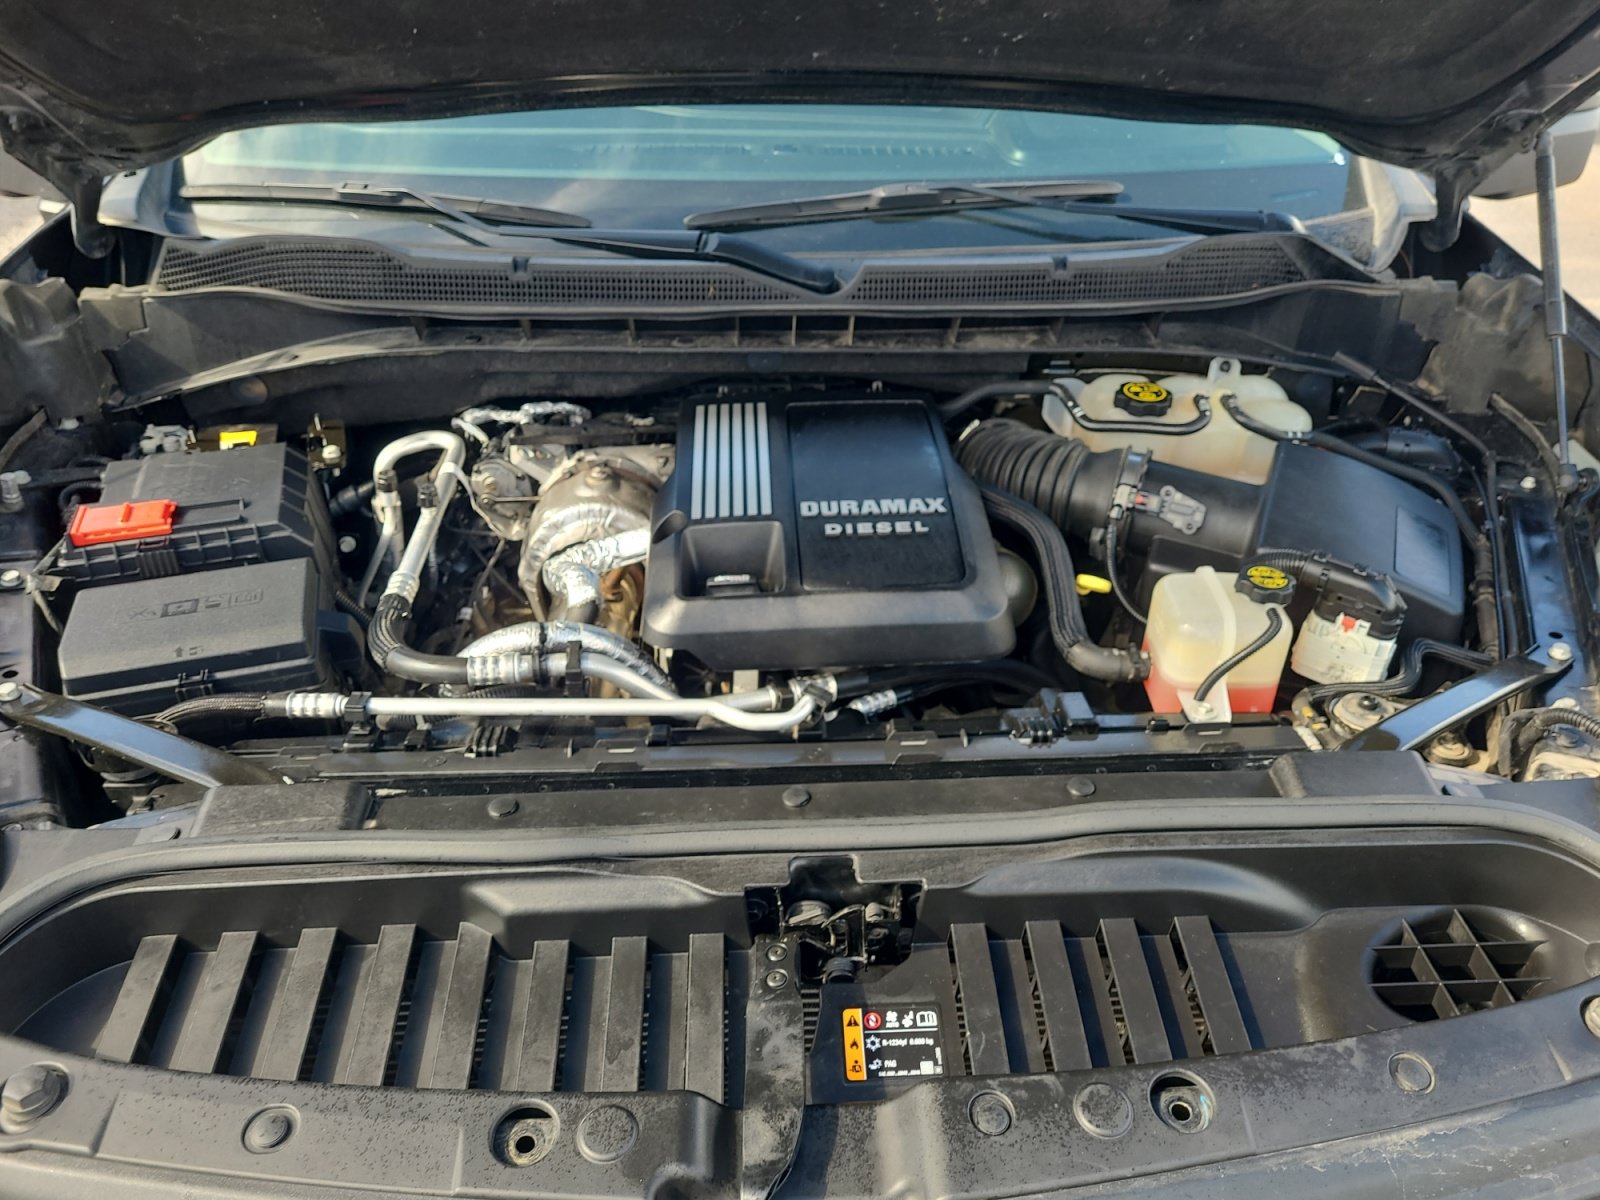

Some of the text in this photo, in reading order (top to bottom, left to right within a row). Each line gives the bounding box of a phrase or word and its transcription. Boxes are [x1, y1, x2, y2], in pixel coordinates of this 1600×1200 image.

[800, 498, 948, 517] DURAMAX
[824, 521, 930, 536] DIESEL
[884, 1059, 897, 1068] PAG
